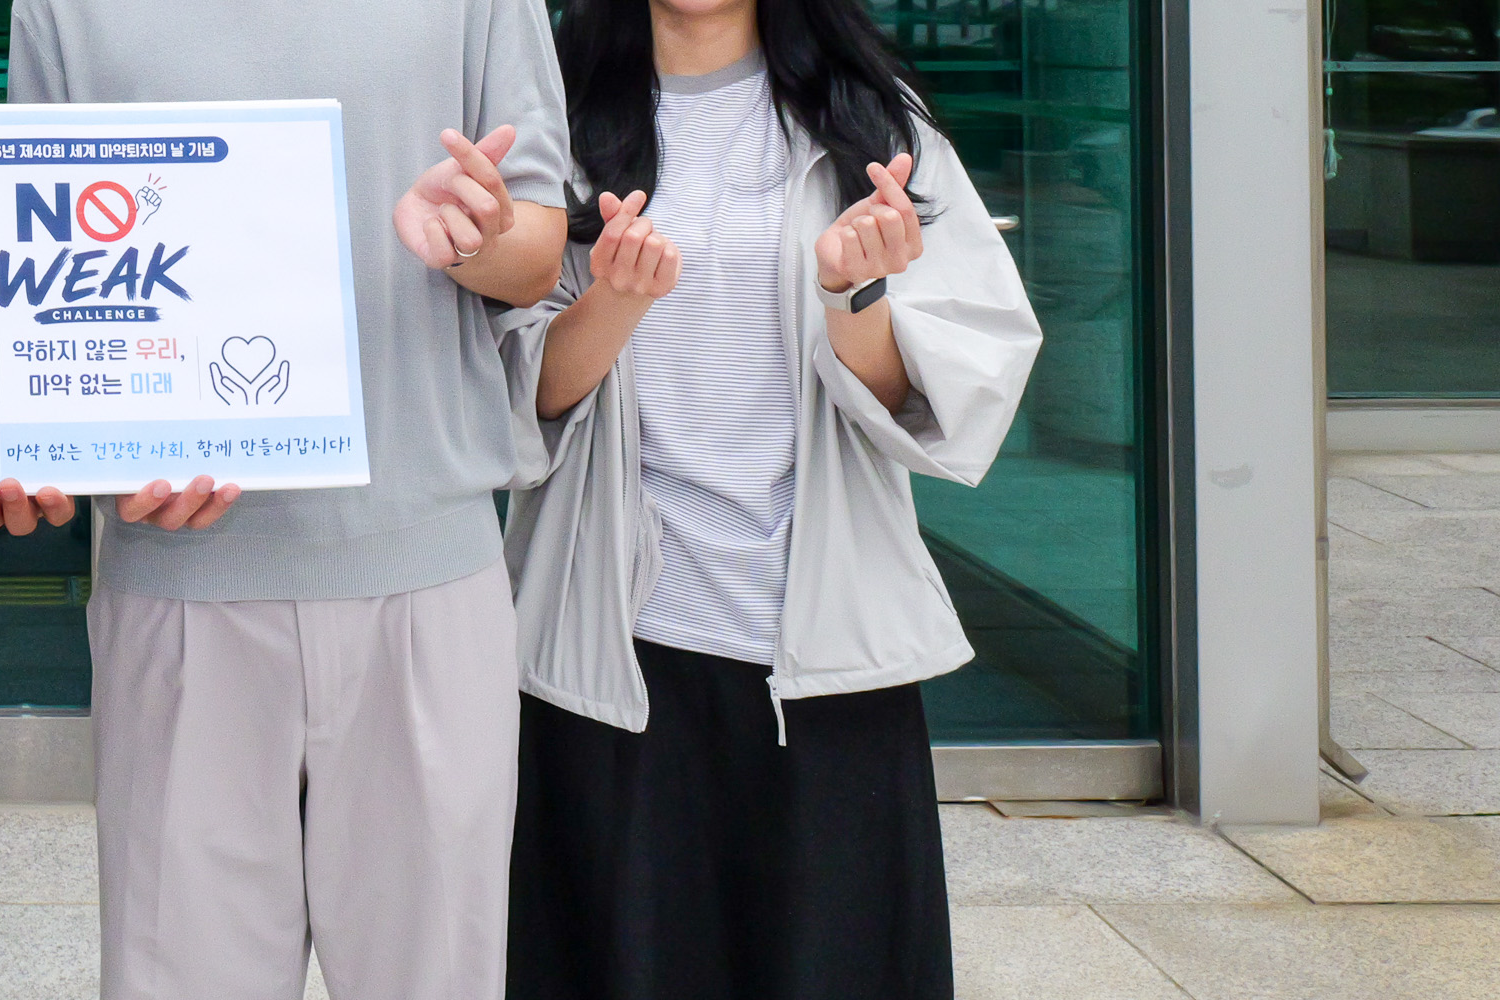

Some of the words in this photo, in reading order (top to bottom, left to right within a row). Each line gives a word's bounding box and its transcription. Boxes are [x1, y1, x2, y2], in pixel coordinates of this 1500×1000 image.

[19, 143, 65, 159] 제40회
[69, 143, 96, 158] 세계
[100, 142, 166, 158] 마약퇴치의
[170, 142, 184, 158] 날
[188, 142, 215, 157] 기념
[52, 309, 146, 321] CHALLENGE
[12, 339, 77, 362] 약하지
[85, 339, 128, 361] 않은
[136, 338, 185, 362] 우리,
[29, 374, 72, 396] 마약
[79, 373, 122, 395] 없는
[130, 372, 173, 394] 미래
[7, 445, 40, 462] 마약
[48, 444, 82, 462] 없는
[91, 441, 143, 461] 건강한
[150, 440, 190, 460] 사회,
[197, 438, 232, 458] 함께
[241, 436, 352, 457] 만들어갑시다!
